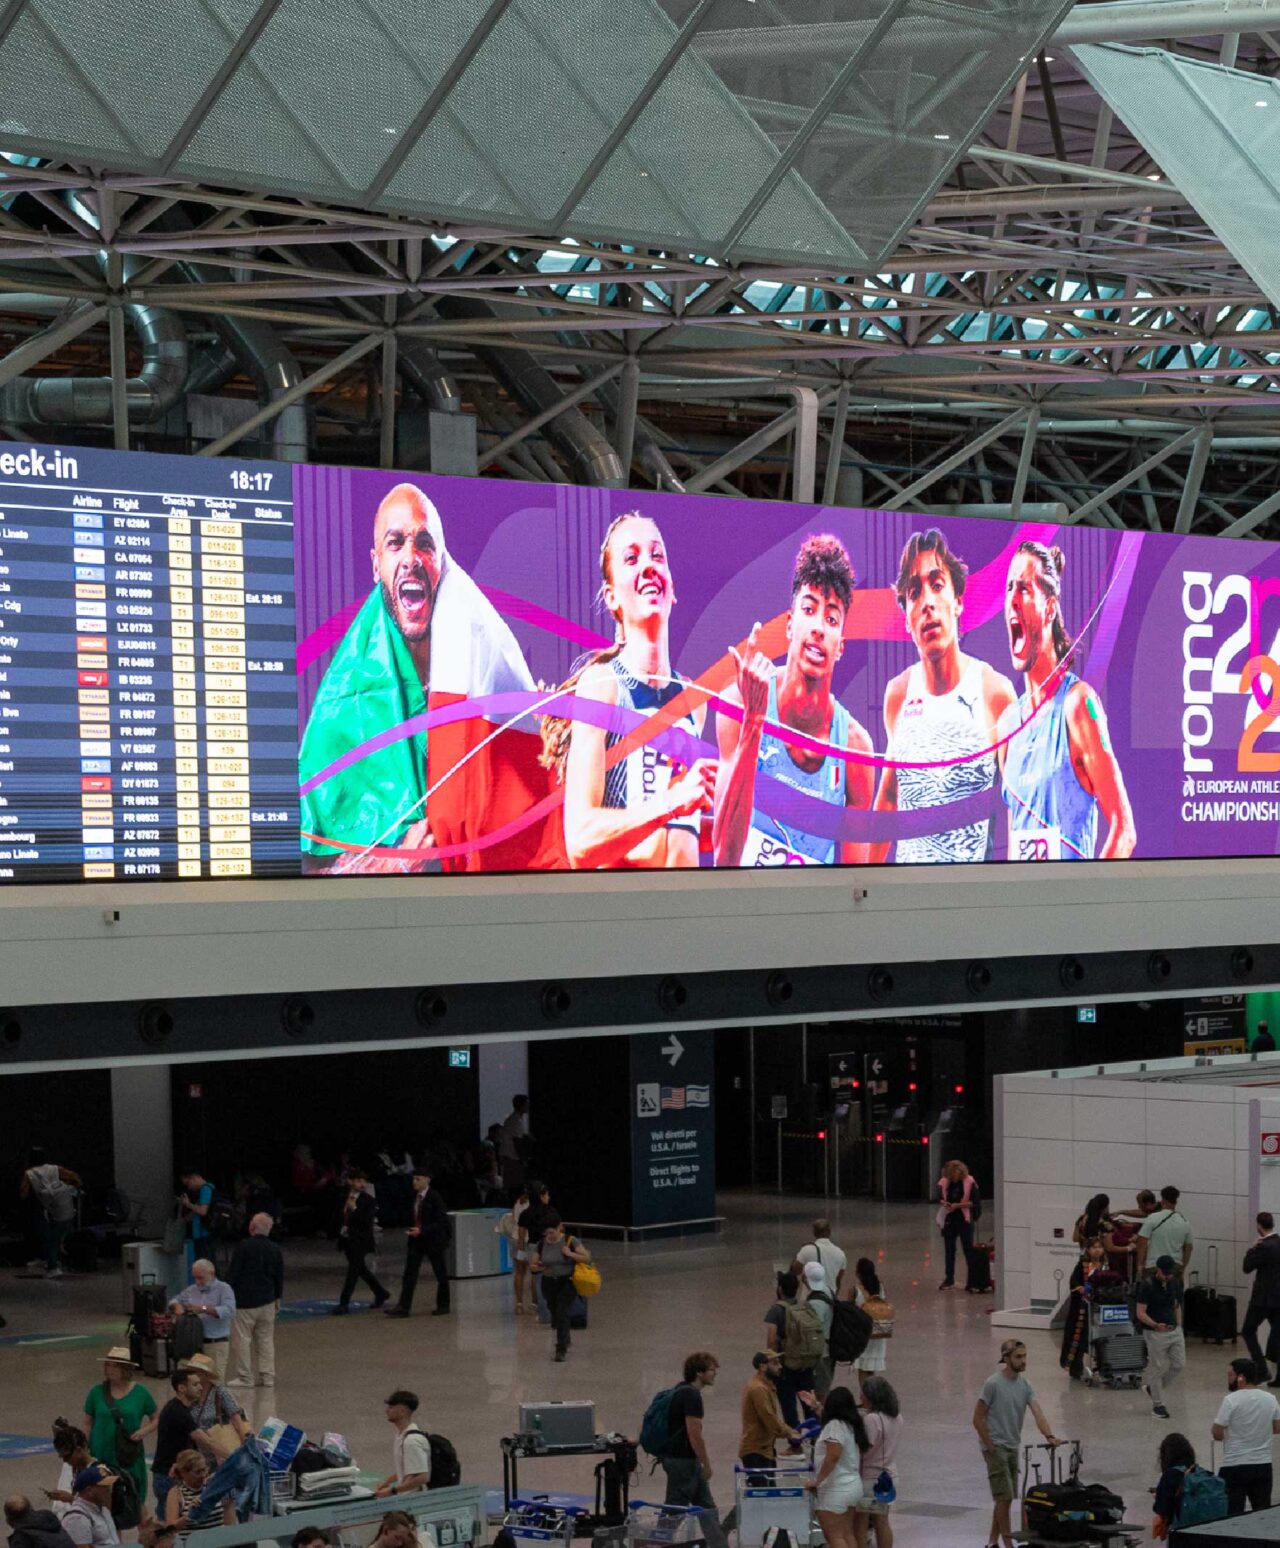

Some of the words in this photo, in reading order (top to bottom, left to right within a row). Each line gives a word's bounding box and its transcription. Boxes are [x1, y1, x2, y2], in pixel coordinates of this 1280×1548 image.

[230, 471, 273, 491] 18:17
[73, 495, 102, 508] Airline
[114, 498, 139, 511] Flight
[255, 507, 282, 520] Status
[1196, 780, 1247, 794] EUROPEAN
[651, 1130, 664, 1141] Voli
[665, 1130, 686, 1140] diretti
[686, 1130, 697, 1140] per
[650, 1166, 669, 1176] Direct
[671, 1165, 690, 1176] flights
[691, 1164, 700, 1172] to
[679, 1175, 696, 1186] Israel
